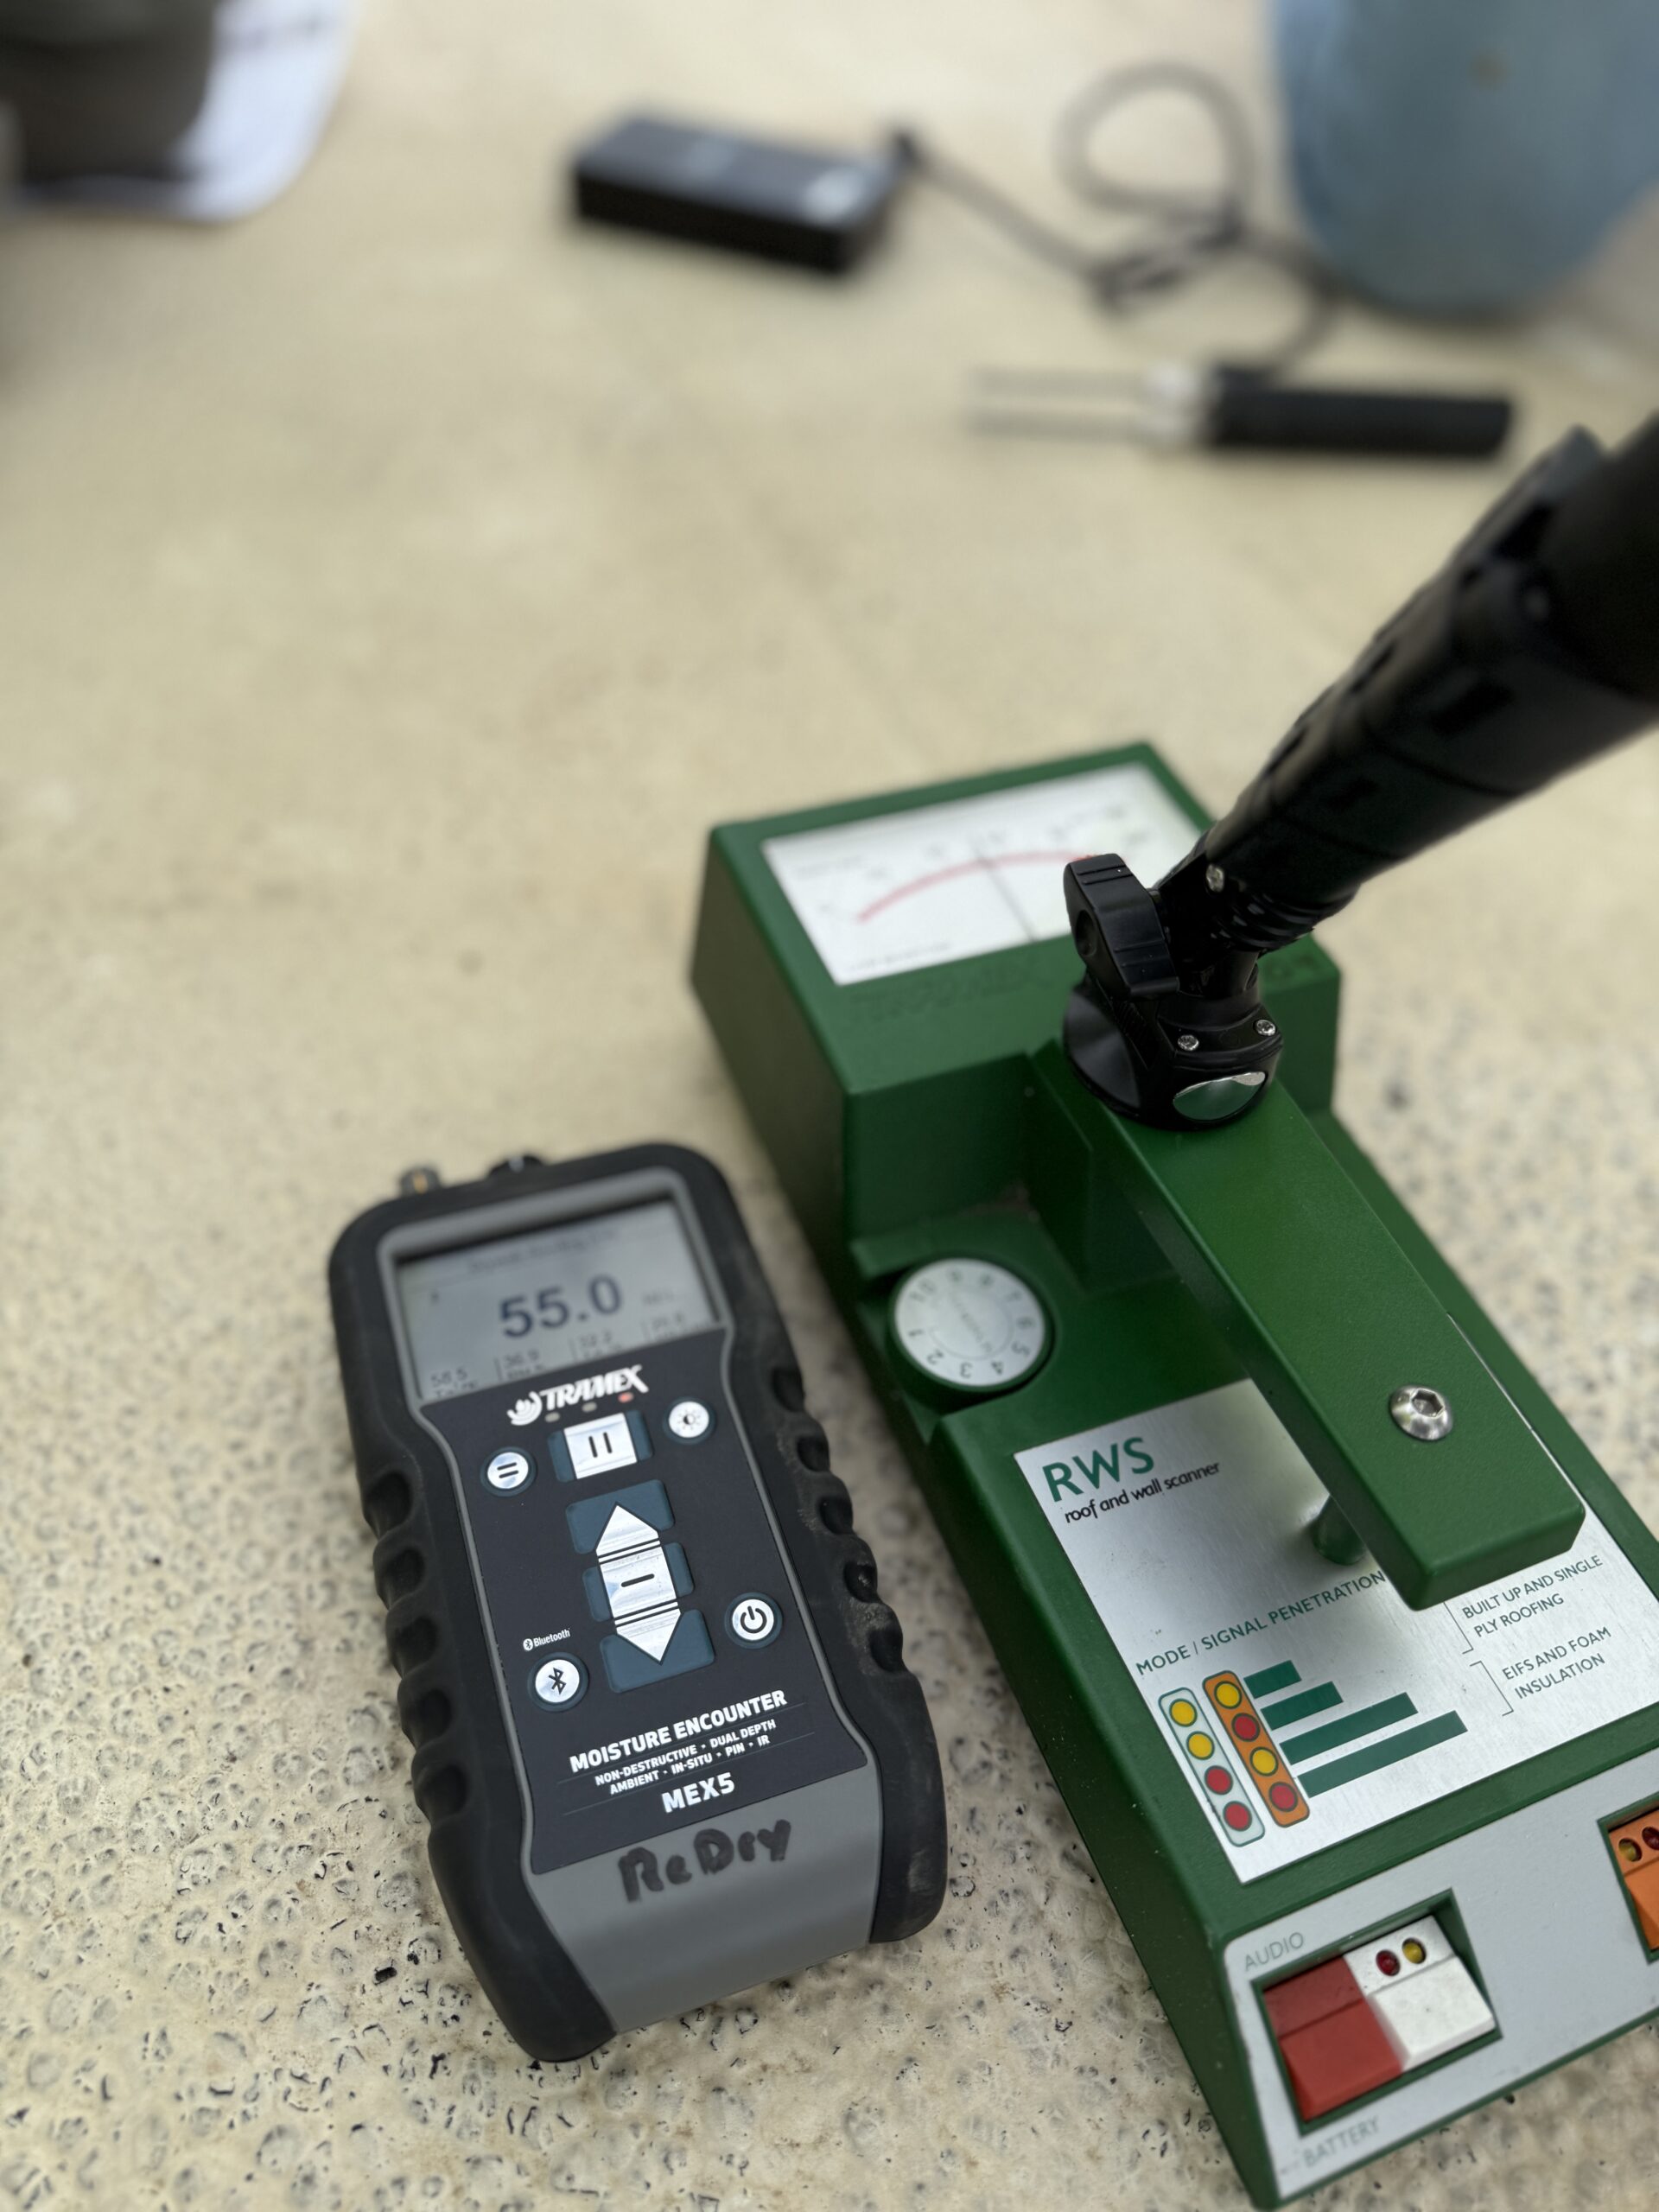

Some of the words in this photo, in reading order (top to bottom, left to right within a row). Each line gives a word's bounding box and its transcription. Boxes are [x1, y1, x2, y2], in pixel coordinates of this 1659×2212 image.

[500, 1274, 622, 1338] 55.0
[959, 1362, 973, 1379] 3
[991, 1360, 1003, 1376] 4
[1010, 1340, 1031, 1357] 5
[539, 1364, 649, 1411] TRAMEX
[1042, 1437, 1154, 1503] RWS
[1065, 1499, 1098, 1523] roof
[1099, 1489, 1130, 1511] and
[1131, 1478, 1163, 1501] wall
[1163, 1462, 1220, 1490] scanner
[1462, 1594, 1501, 1619] BUILT
[1502, 1586, 1522, 1602] UP
[1523, 1574, 1554, 1595] AND
[1554, 1554, 1603, 1581] SINGLE
[533, 1629, 570, 1648] Bluetooth
[1135, 1644, 1191, 1675] MODE
[1201, 1617, 1268, 1650] SIGNAL
[1268, 1569, 1386, 1624] PENETRATION
[1474, 1618, 1498, 1637] PLY
[1499, 1593, 1565, 1626] ROOFING
[1502, 1659, 1535, 1680] EIFS
[1535, 1645, 1567, 1667] AND
[1567, 1626, 1611, 1652] FOAM
[1514, 1652, 1605, 1700] INSULATION
[569, 1726, 672, 1773] MOISTURE
[673, 1690, 787, 1739] ENCOUNTER
[594, 1745, 697, 1786] NON-DESTRUCTIVE
[709, 1732, 740, 1748] DUAL
[741, 1719, 776, 1738] DEPTH
[610, 1770, 659, 1795] AMBIENT
[671, 1752, 713, 1775] IN-SITU
[725, 1742, 745, 1758] PIN
[757, 1734, 770, 1747] IR
[661, 1772, 734, 1814] MEX5
[1244, 1932, 1304, 1972] AUDIO
[1303, 2115, 1379, 2168] BATTERY
